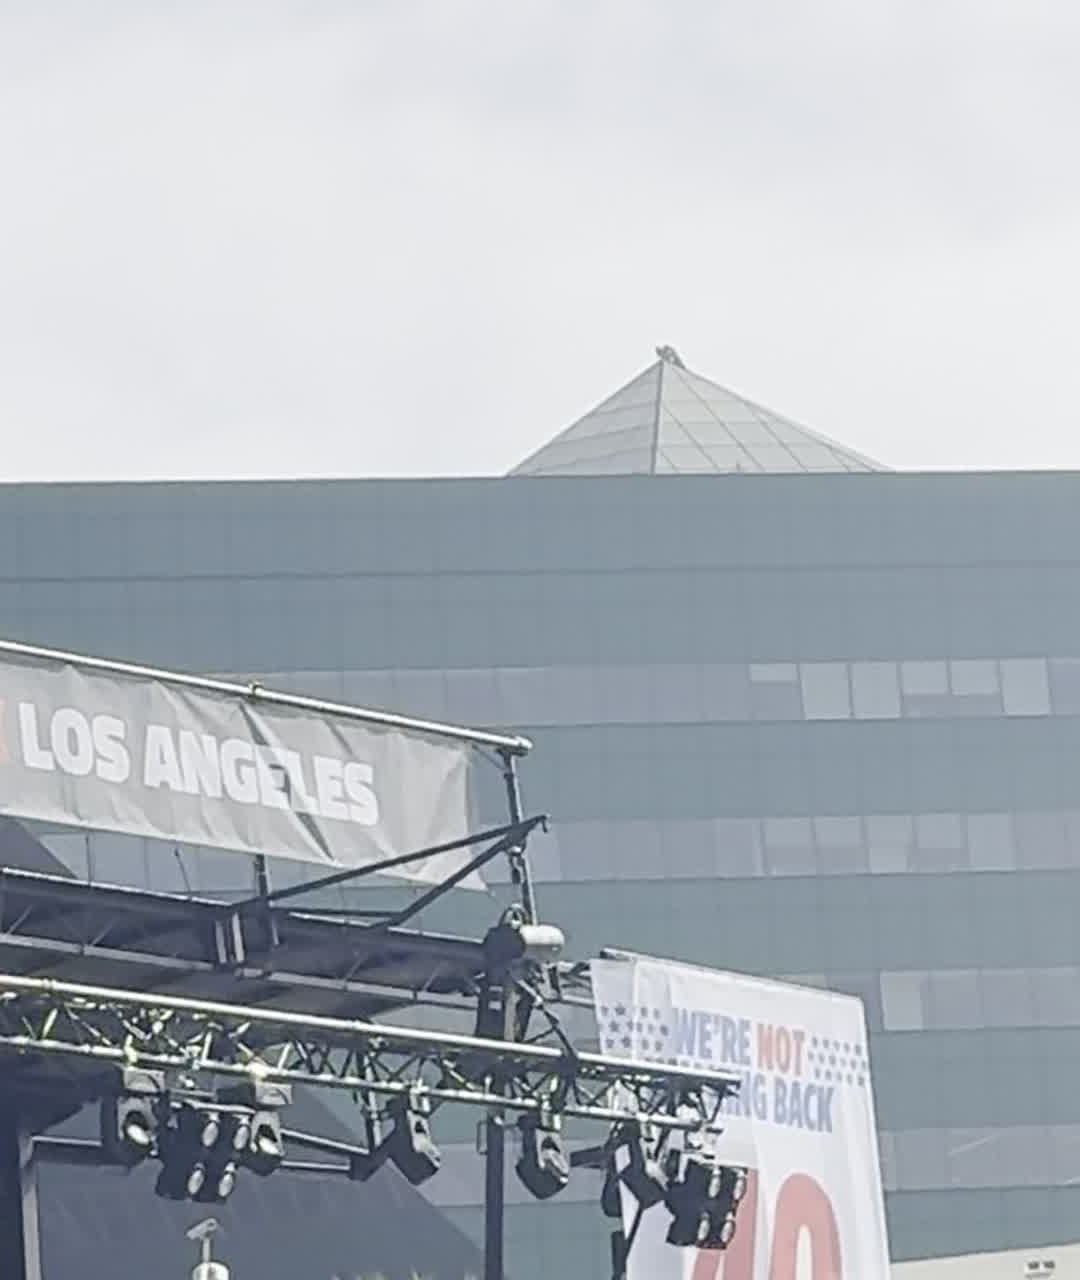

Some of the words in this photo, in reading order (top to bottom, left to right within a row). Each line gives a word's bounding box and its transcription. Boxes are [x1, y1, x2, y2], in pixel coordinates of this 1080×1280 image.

[19, 702, 131, 784] LOS
[143, 724, 380, 826] ANGELES
[757, 1023, 805, 1077] NOT
[773, 1075, 834, 1134] BACK
